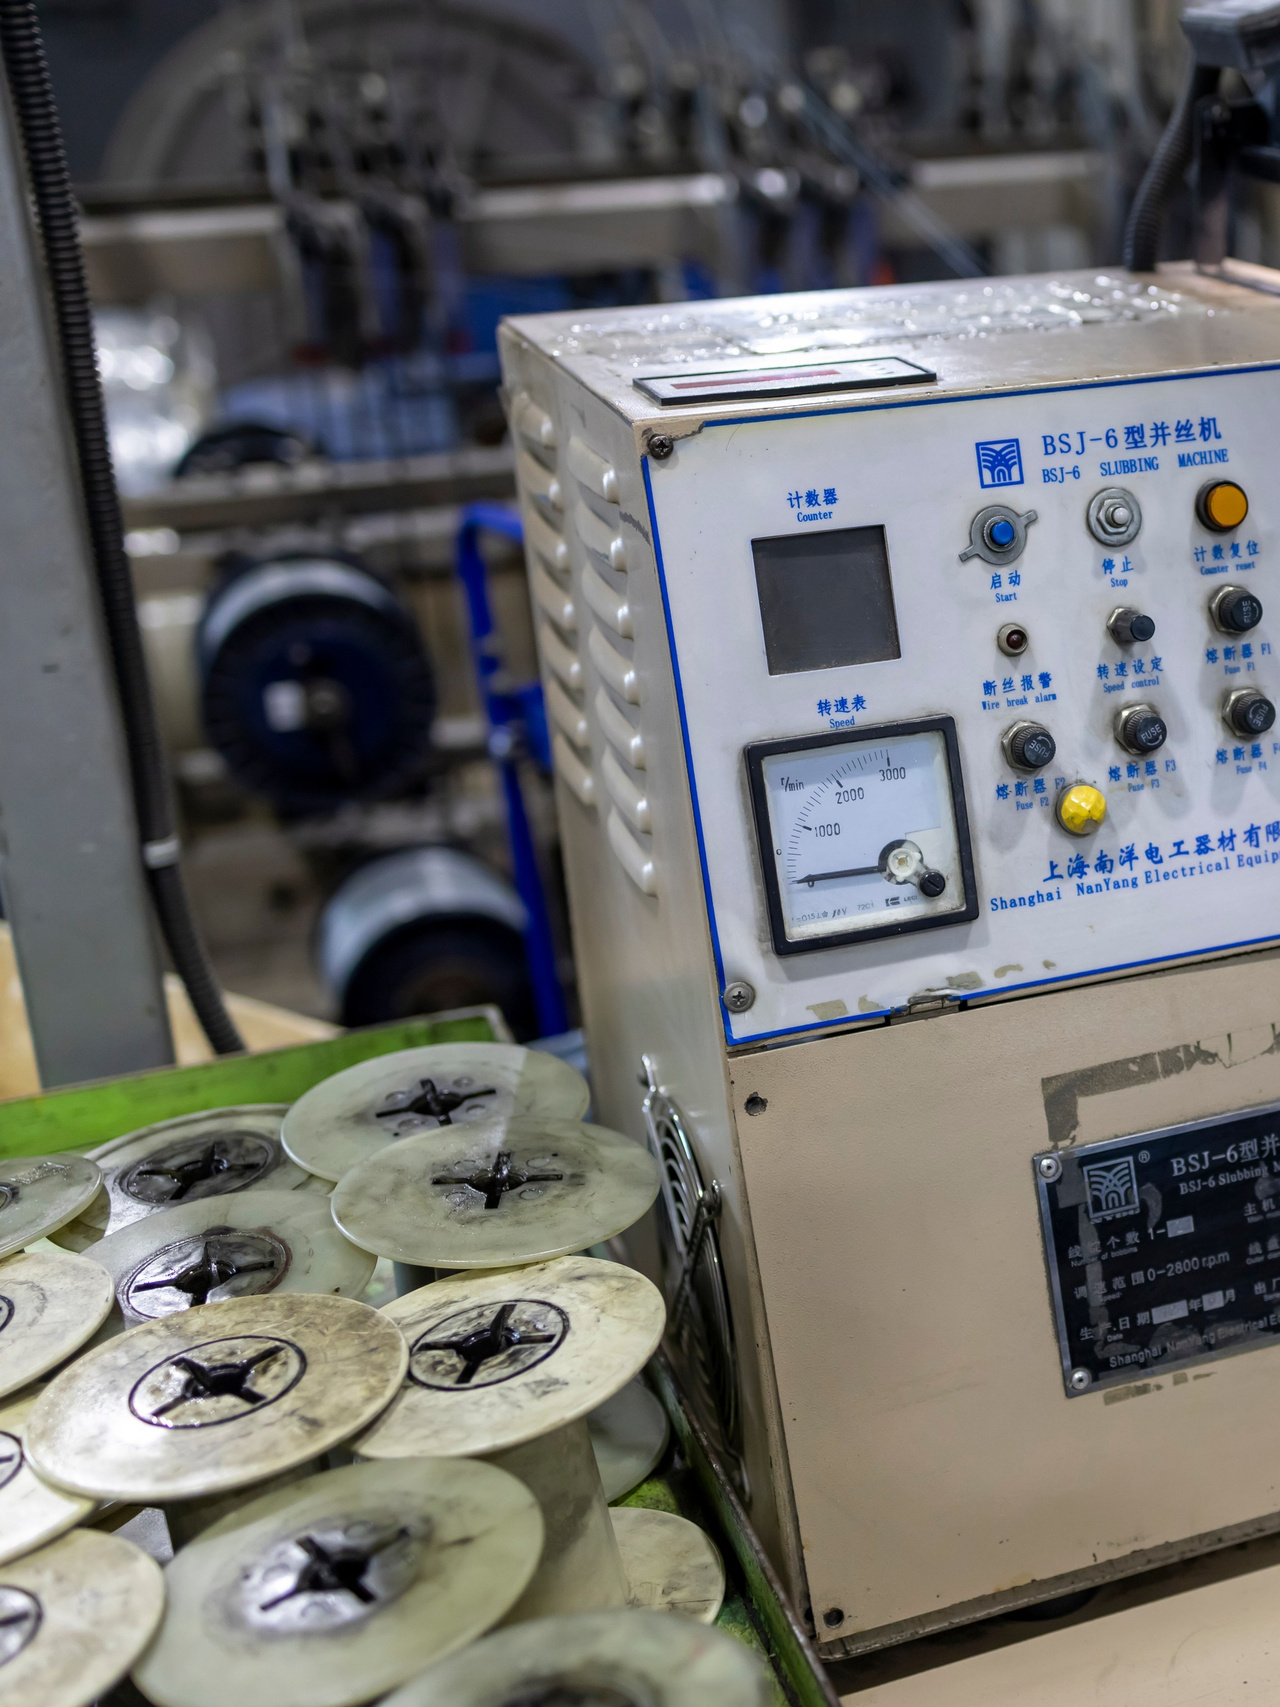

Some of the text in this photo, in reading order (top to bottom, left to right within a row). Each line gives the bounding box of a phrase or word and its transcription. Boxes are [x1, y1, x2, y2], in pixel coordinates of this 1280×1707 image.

[1042, 417, 1221, 455] BSJ-6型并丝机
[1042, 449, 1229, 483] BSJ-6 SLUBBING MACHINE
[787, 488, 839, 508] 计数器
[797, 511, 833, 523] Counter
[1194, 540, 1260, 562] 计数复位
[1101, 556, 1134, 575] 停止
[1200, 562, 1255, 576] Counter reset
[990, 570, 1021, 590] 启动
[1111, 578, 1128, 588] Stop
[996, 592, 1017, 602] Start
[1242, 601, 1252, 623] FUSE
[1097, 656, 1164, 680] 转速设定
[1224, 665, 1240, 675] Fuse
[982, 672, 1052, 696] 断丝报警
[1103, 676, 1159, 693] Speed control
[816, 694, 867, 716] 转速表
[982, 693, 1057, 711] Wire break alarm
[829, 716, 855, 729] Speed
[1253, 703, 1268, 726] FUSE
[1141, 724, 1162, 742] FUSE
[1029, 740, 1050, 758] FUSE
[879, 766, 906, 782] 3000
[1165, 760, 1177, 772] F3
[1236, 762, 1267, 775] Fuse F4
[996, 777, 1066, 800] 熔断器 F2
[1128, 779, 1160, 792] Fuse F3
[836, 787, 865, 804] 2000
[1016, 797, 1049, 811] Fuse F2
[814, 823, 841, 838] 1000
[990, 887, 1062, 912] Shanghai
[1076, 876, 1138, 896] NanYang
[1145, 857, 1230, 884] Electrical
[1179, 1175, 1216, 1195] BSJ-6
[1218, 1165, 1270, 1185] Slubbing
[1147, 1257, 1200, 1281] 0-2800
[1107, 1333, 1123, 1343] Date
[1109, 1343, 1162, 1368] Shanghai
